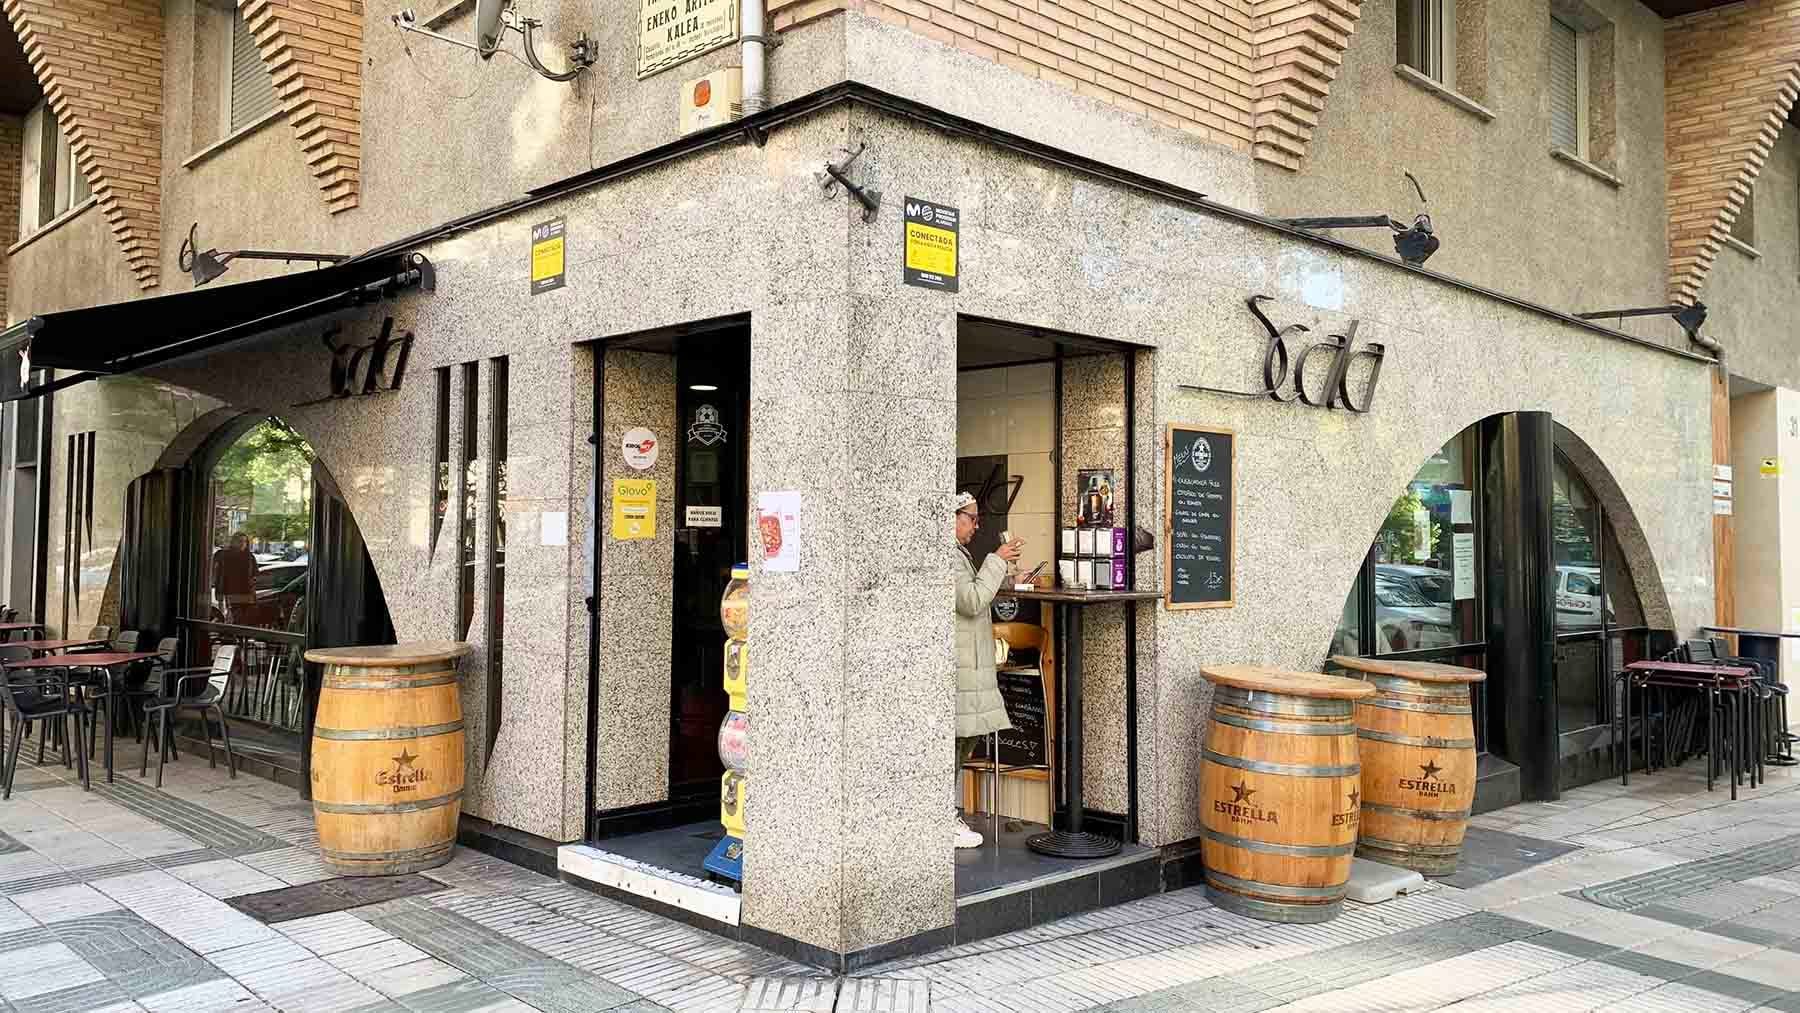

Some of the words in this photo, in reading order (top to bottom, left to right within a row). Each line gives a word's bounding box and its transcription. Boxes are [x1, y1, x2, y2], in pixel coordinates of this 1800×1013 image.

[647, 6, 677, 32] ENEKO
[667, 15, 698, 43] KALEA
[910, 229, 953, 247] CONECTADA
[618, 486, 648, 497] Glovo
[376, 767, 432, 786] Estrella
[1399, 778, 1456, 794] ESTRELLA
[1418, 790, 1440, 799] DAMM
[1214, 800, 1279, 825] ESTRELLA
[1231, 816, 1253, 825] DAMM
